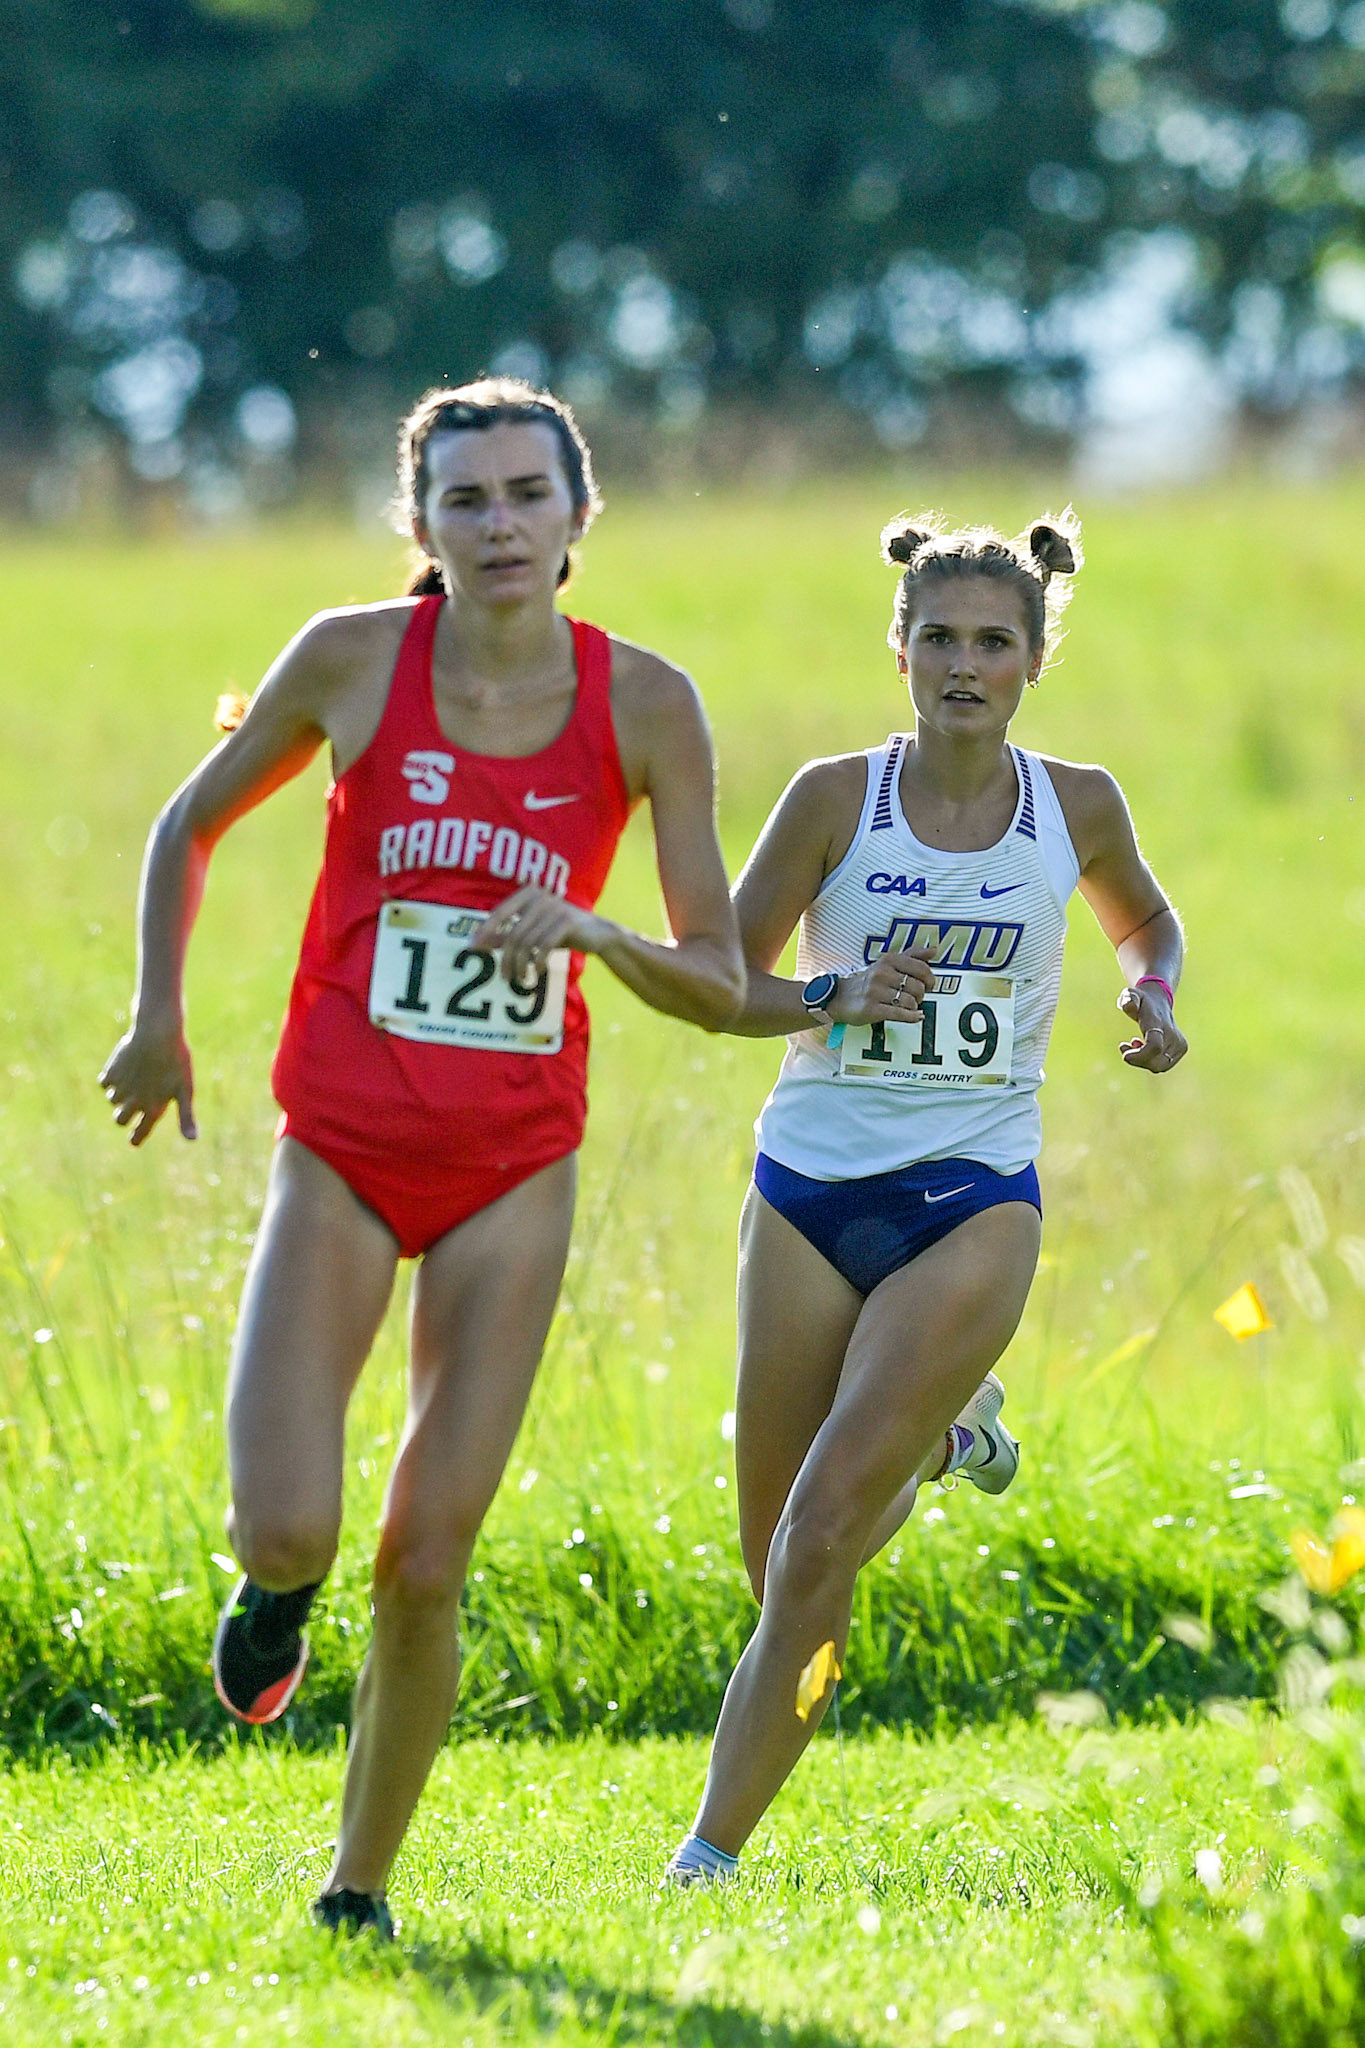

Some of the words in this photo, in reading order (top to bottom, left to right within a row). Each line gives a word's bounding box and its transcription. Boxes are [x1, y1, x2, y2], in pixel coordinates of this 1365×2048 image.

[379, 817, 571, 899] RADFORD
[866, 872, 926, 896] CAA
[864, 918, 1025, 971] JMU
[883, 1069, 918, 1080] CROSS
[921, 1072, 973, 1083] COUNTRY
